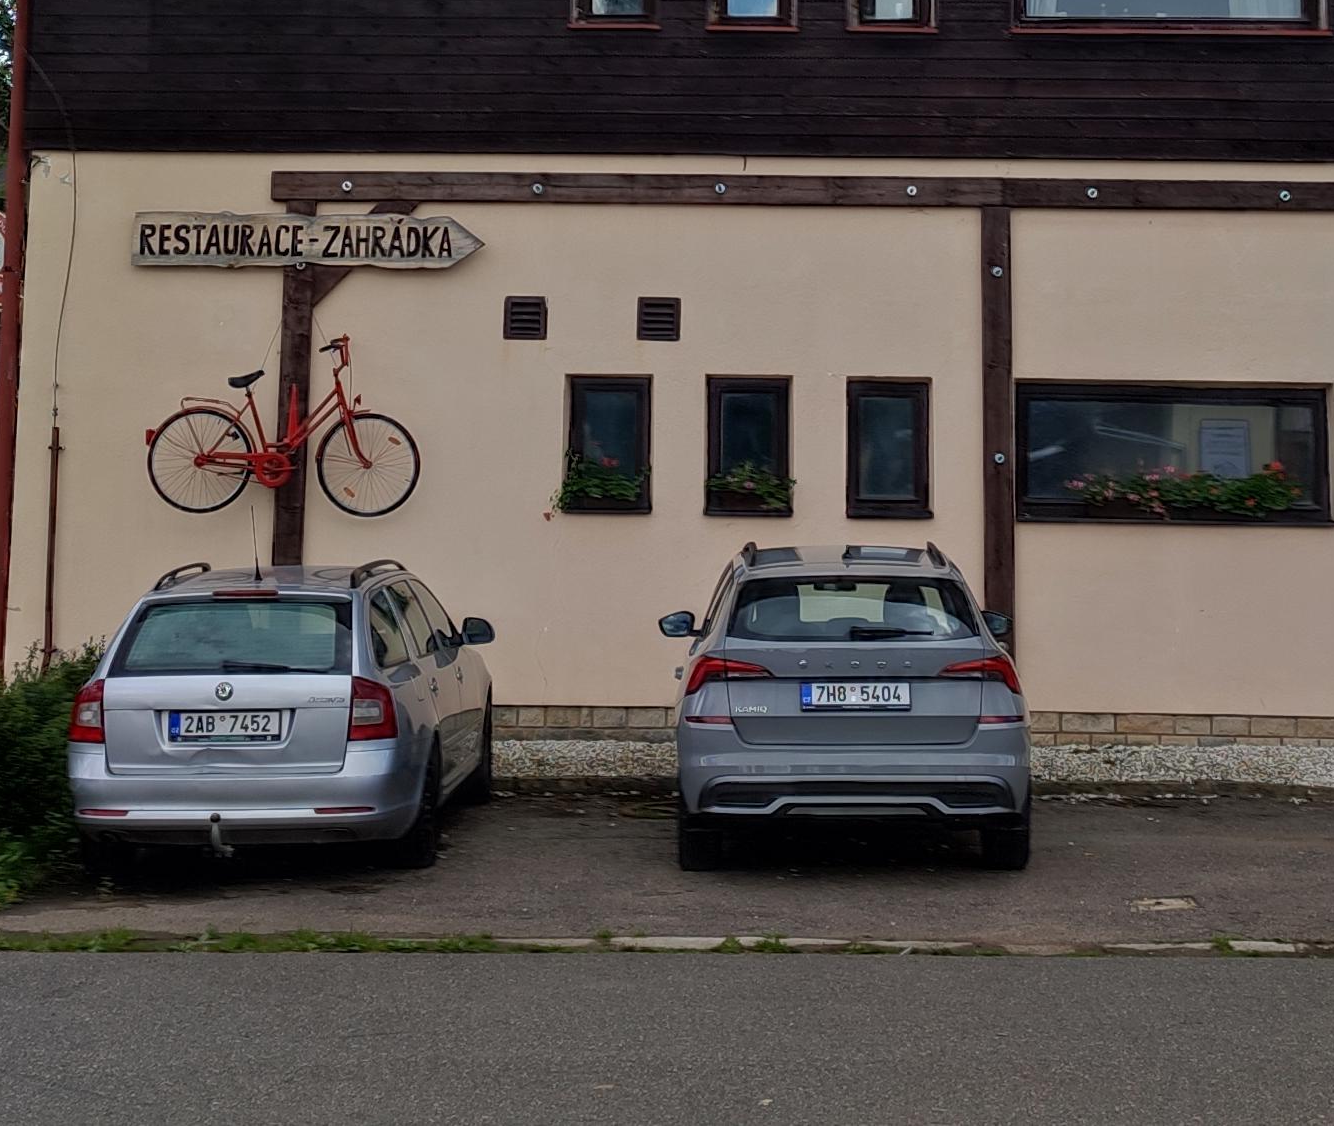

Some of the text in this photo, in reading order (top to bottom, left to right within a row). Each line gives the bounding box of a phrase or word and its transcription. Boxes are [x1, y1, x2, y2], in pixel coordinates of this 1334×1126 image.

[816, 685, 847, 703] 7H8
[860, 685, 902, 703] 5404
[734, 705, 768, 714] KAMIQ
[184, 715, 216, 734] 2AB
[229, 715, 271, 733] 7452
